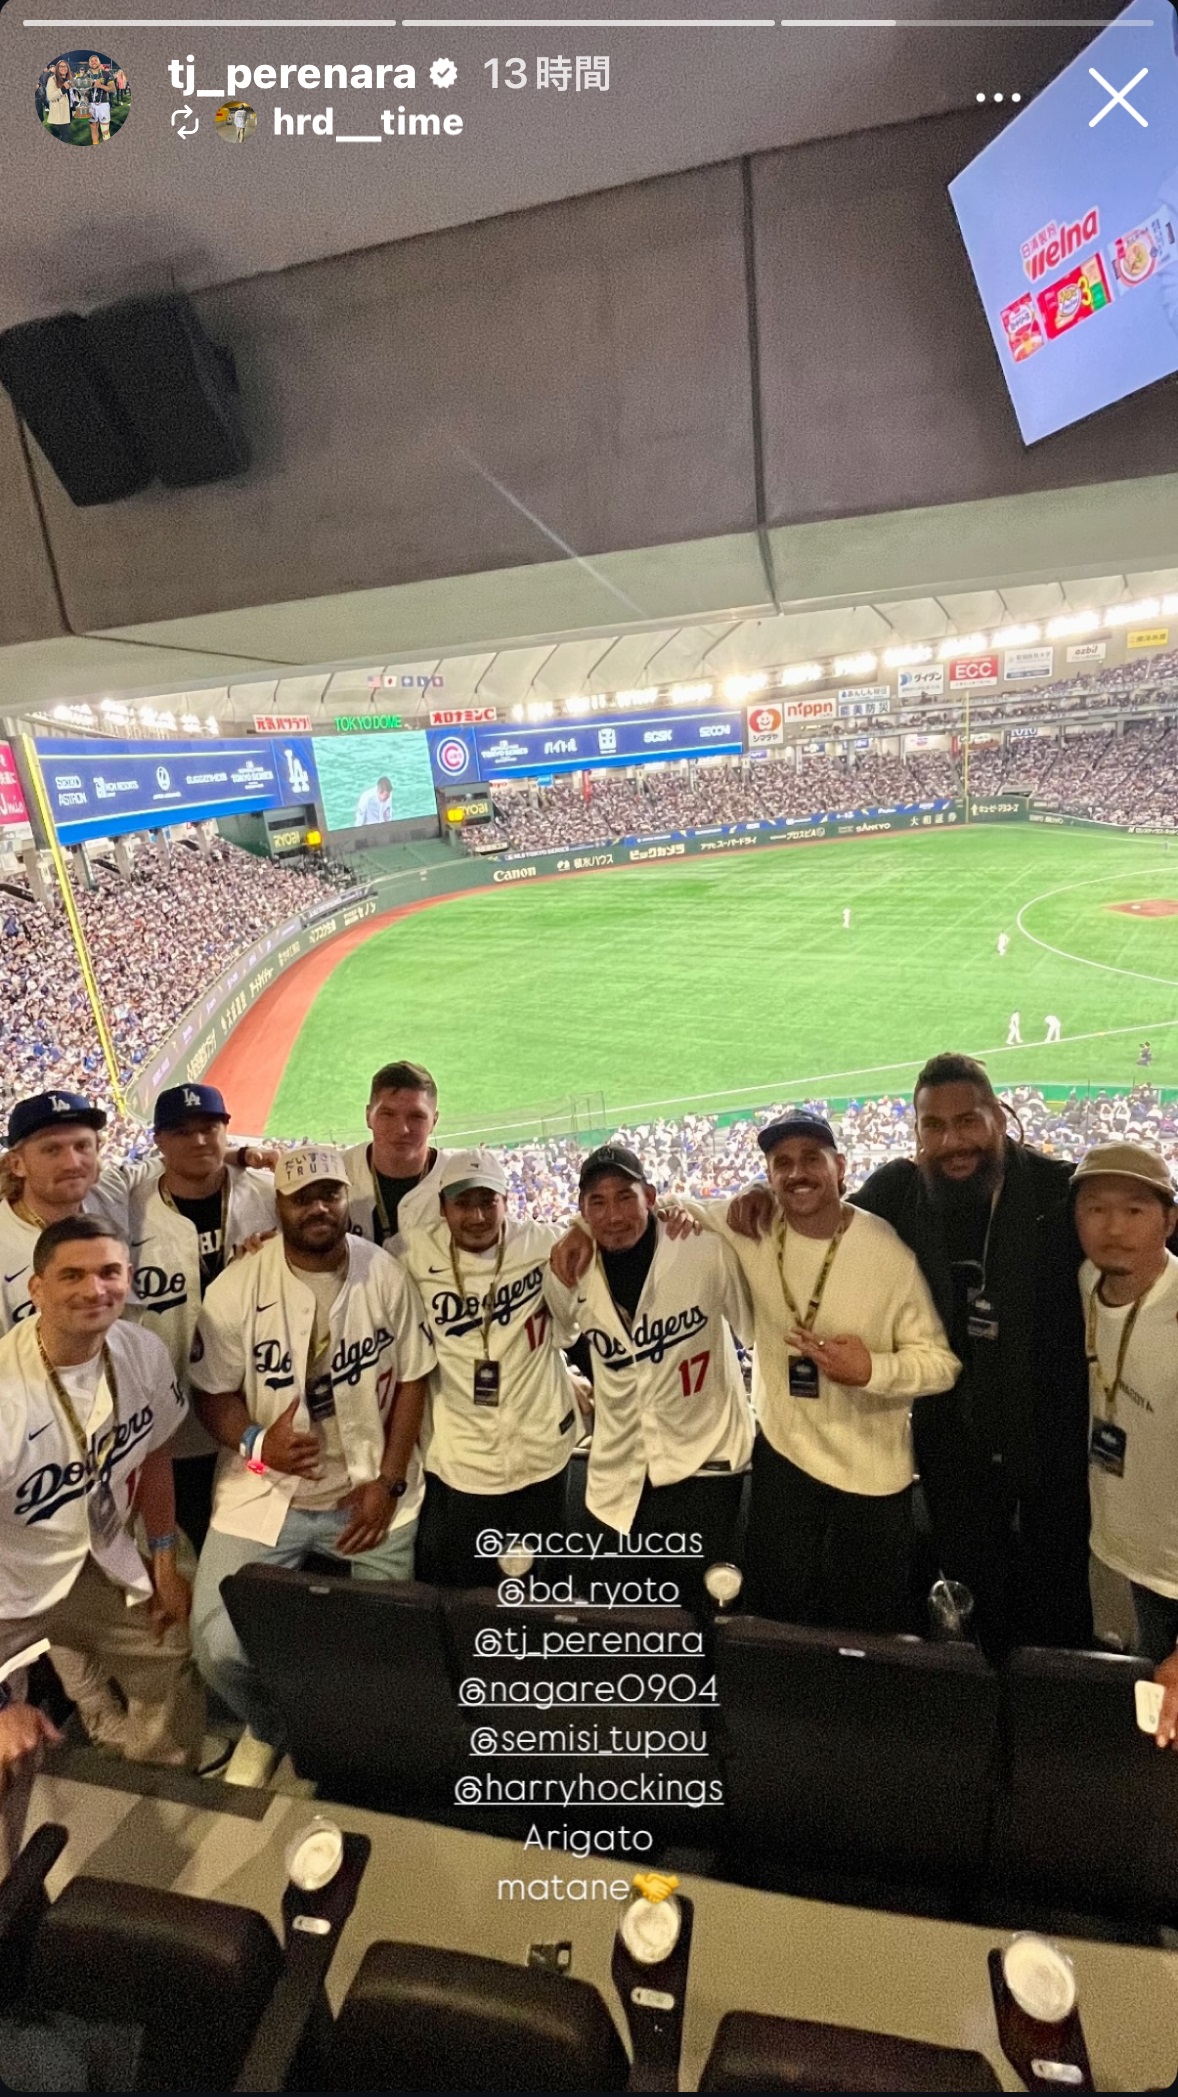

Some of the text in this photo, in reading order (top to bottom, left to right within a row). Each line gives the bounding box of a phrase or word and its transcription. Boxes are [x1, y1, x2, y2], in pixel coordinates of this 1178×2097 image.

[1077, 275, 1093, 306] 3
[1075, 645, 1097, 655] azbil
[955, 663, 992, 679] ECC
[432, 708, 495, 725] オロナミンC
[788, 702, 832, 717] nippn
[334, 714, 402, 731] TOKYO DOME
[753, 734, 778, 743] シマダヤ
[284, 749, 310, 793] LA
[856, 822, 891, 832] SANKYO
[273, 832, 300, 848] RYOBI
[493, 867, 536, 882] Canon
[49, 1094, 70, 1111] LA
[182, 1088, 201, 1106] LA
[524, 1305, 552, 1351] 17
[678, 1350, 710, 1397] 17
